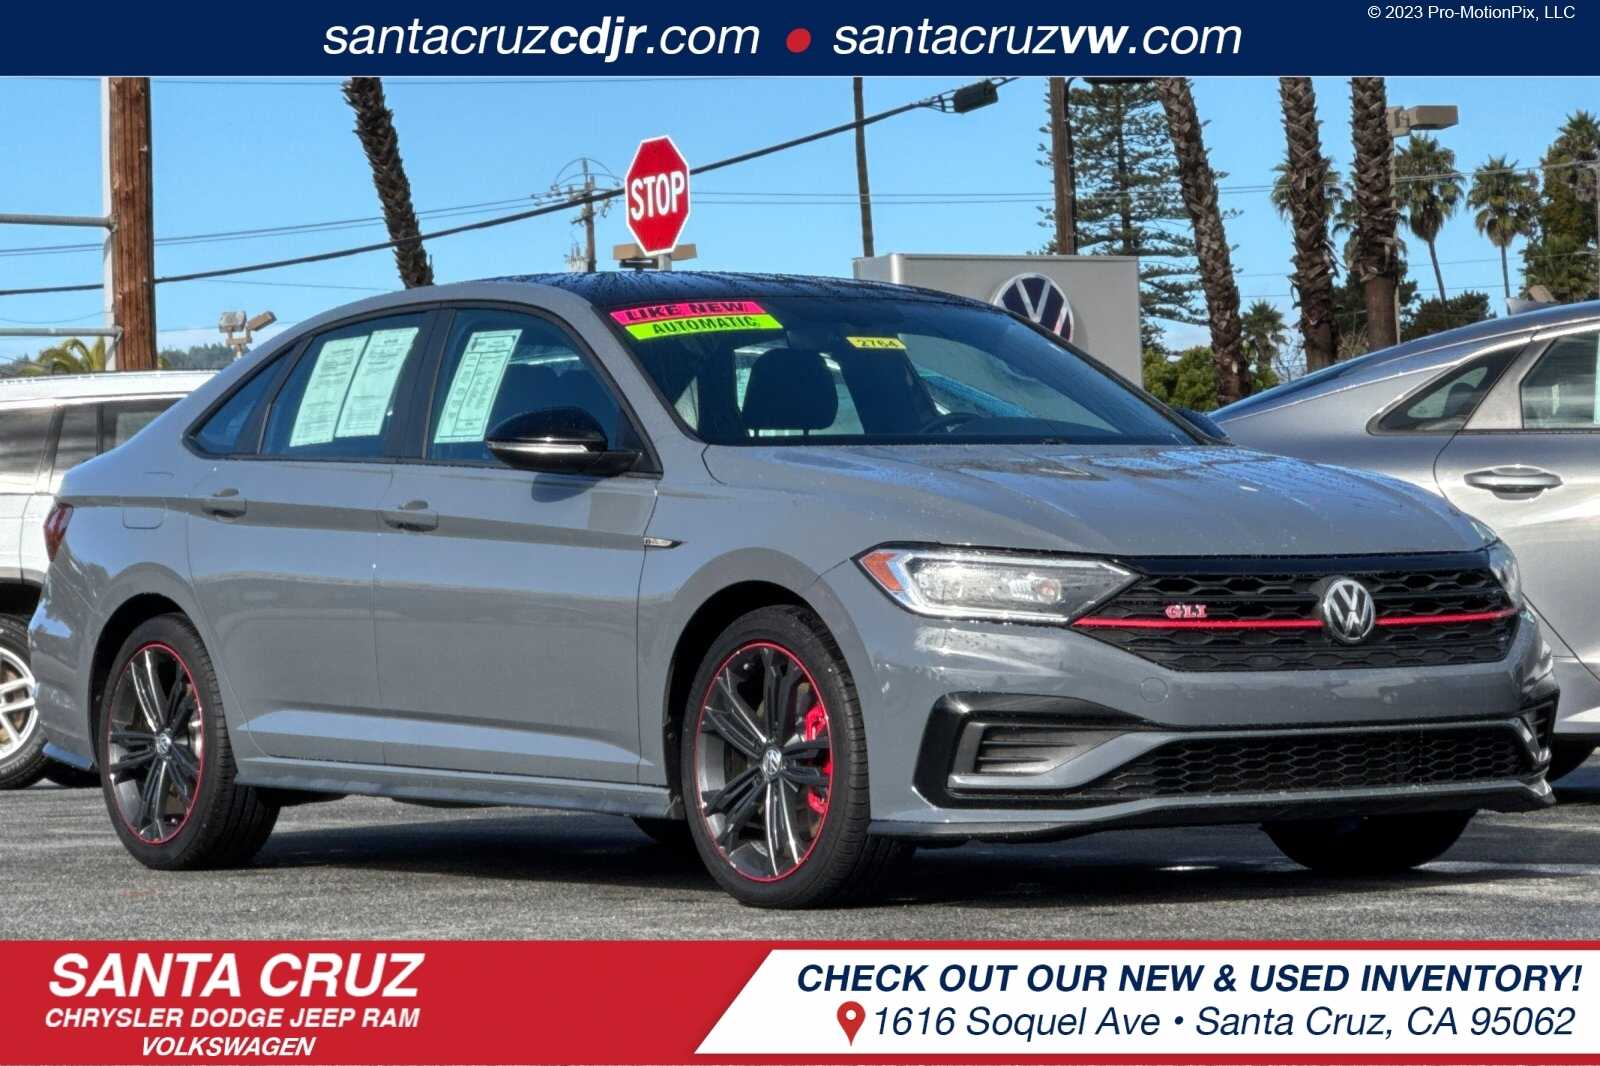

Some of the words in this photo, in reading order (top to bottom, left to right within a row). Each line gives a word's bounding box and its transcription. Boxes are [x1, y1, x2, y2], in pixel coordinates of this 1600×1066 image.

[630, 170, 685, 221] STOP
[624, 303, 680, 322] LIKE
[688, 301, 745, 315] NEW
[651, 315, 758, 335] AUTOMATIC
[1164, 604, 1208, 619] GLI
